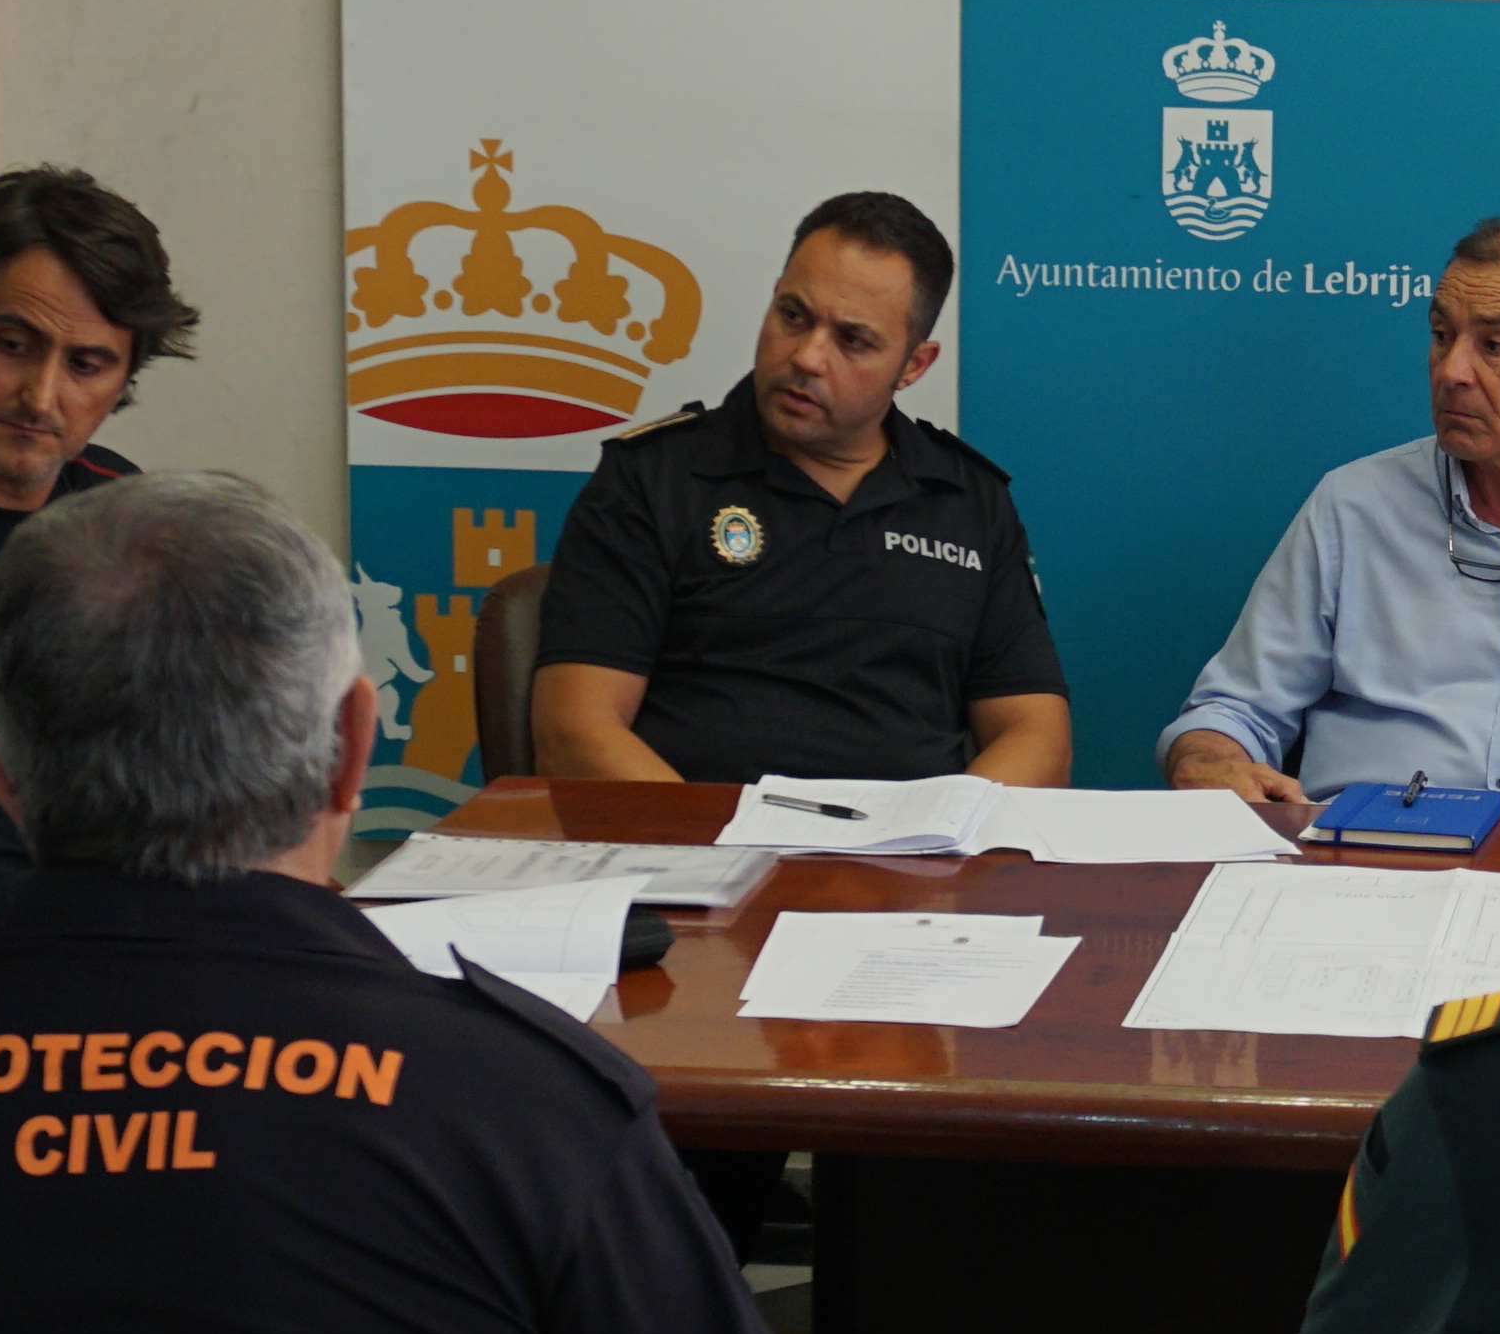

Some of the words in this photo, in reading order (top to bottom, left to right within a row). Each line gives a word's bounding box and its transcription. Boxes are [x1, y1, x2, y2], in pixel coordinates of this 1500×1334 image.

[996, 253, 1241, 298] Ayuntamiento
[1252, 258, 1293, 293] de
[1304, 260, 1434, 308] Lebrija
[883, 530, 984, 572] POLICIA
[14, 1109, 217, 1177] CIVIL
